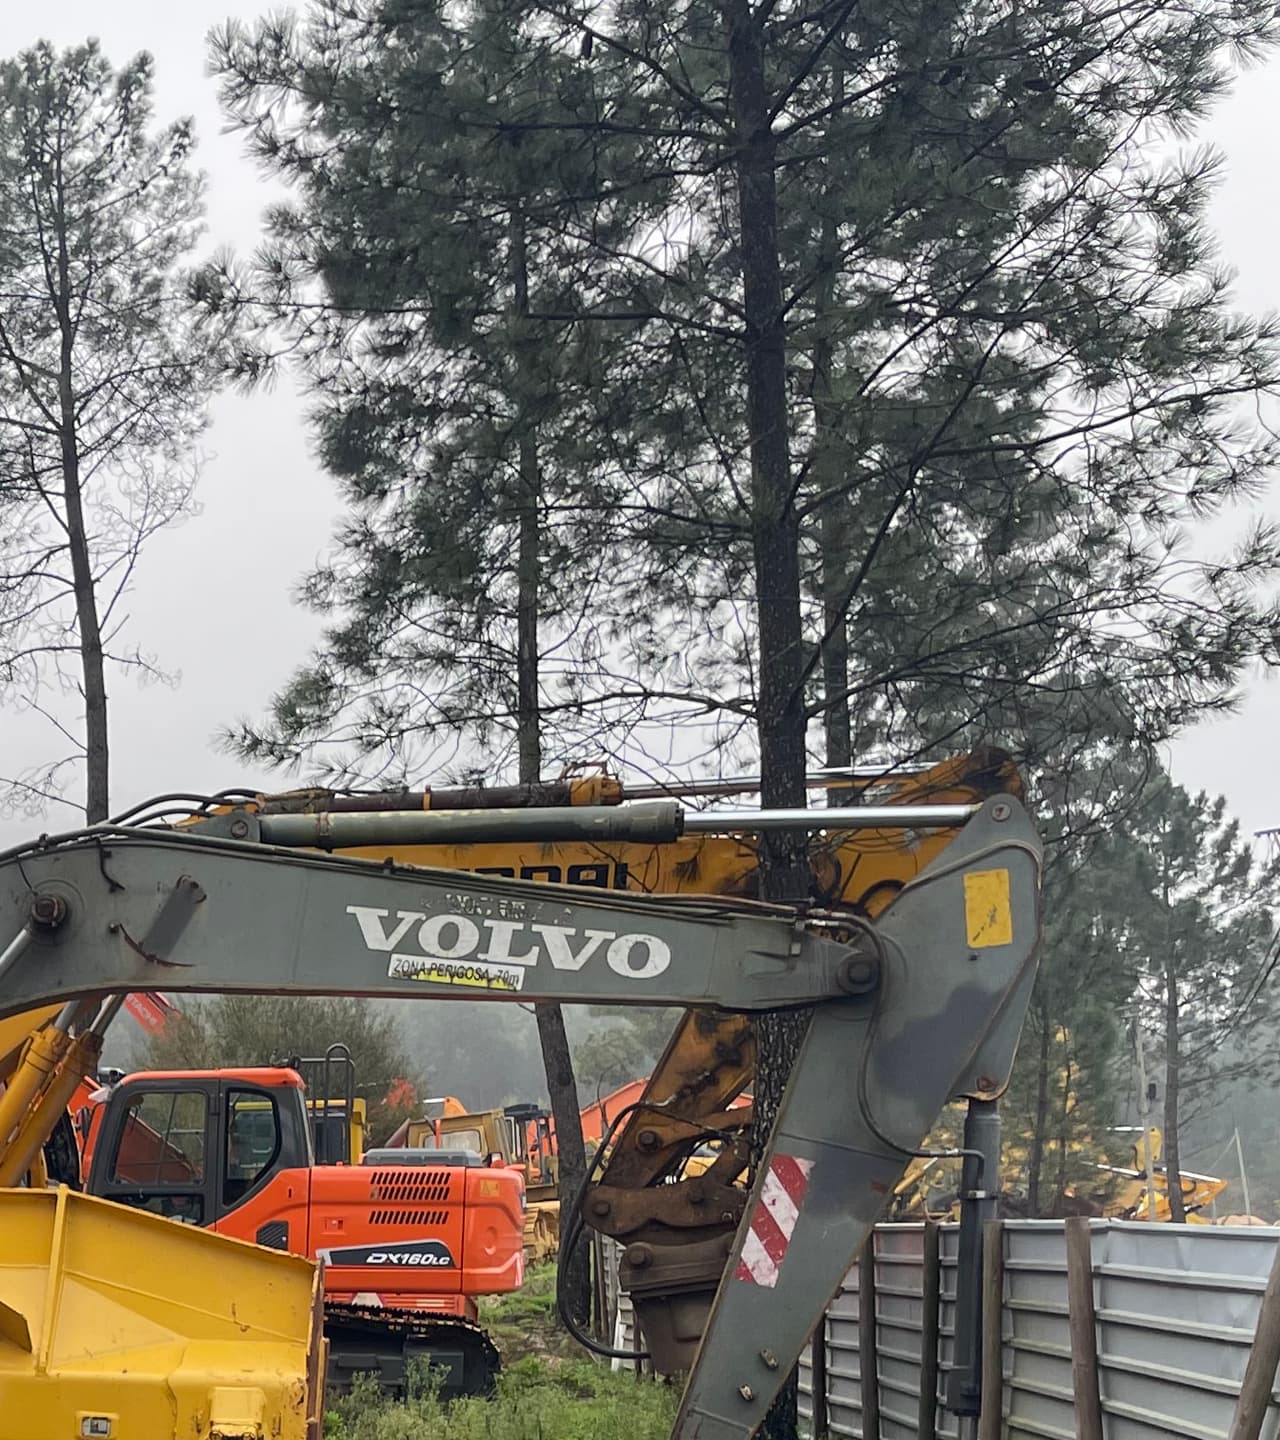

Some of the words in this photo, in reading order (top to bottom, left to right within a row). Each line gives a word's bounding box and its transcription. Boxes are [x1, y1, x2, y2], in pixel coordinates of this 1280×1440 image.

[346, 905, 671, 979] VOLVO
[393, 958, 426, 977] ZONA
[430, 962, 490, 981] PERIGOSA
